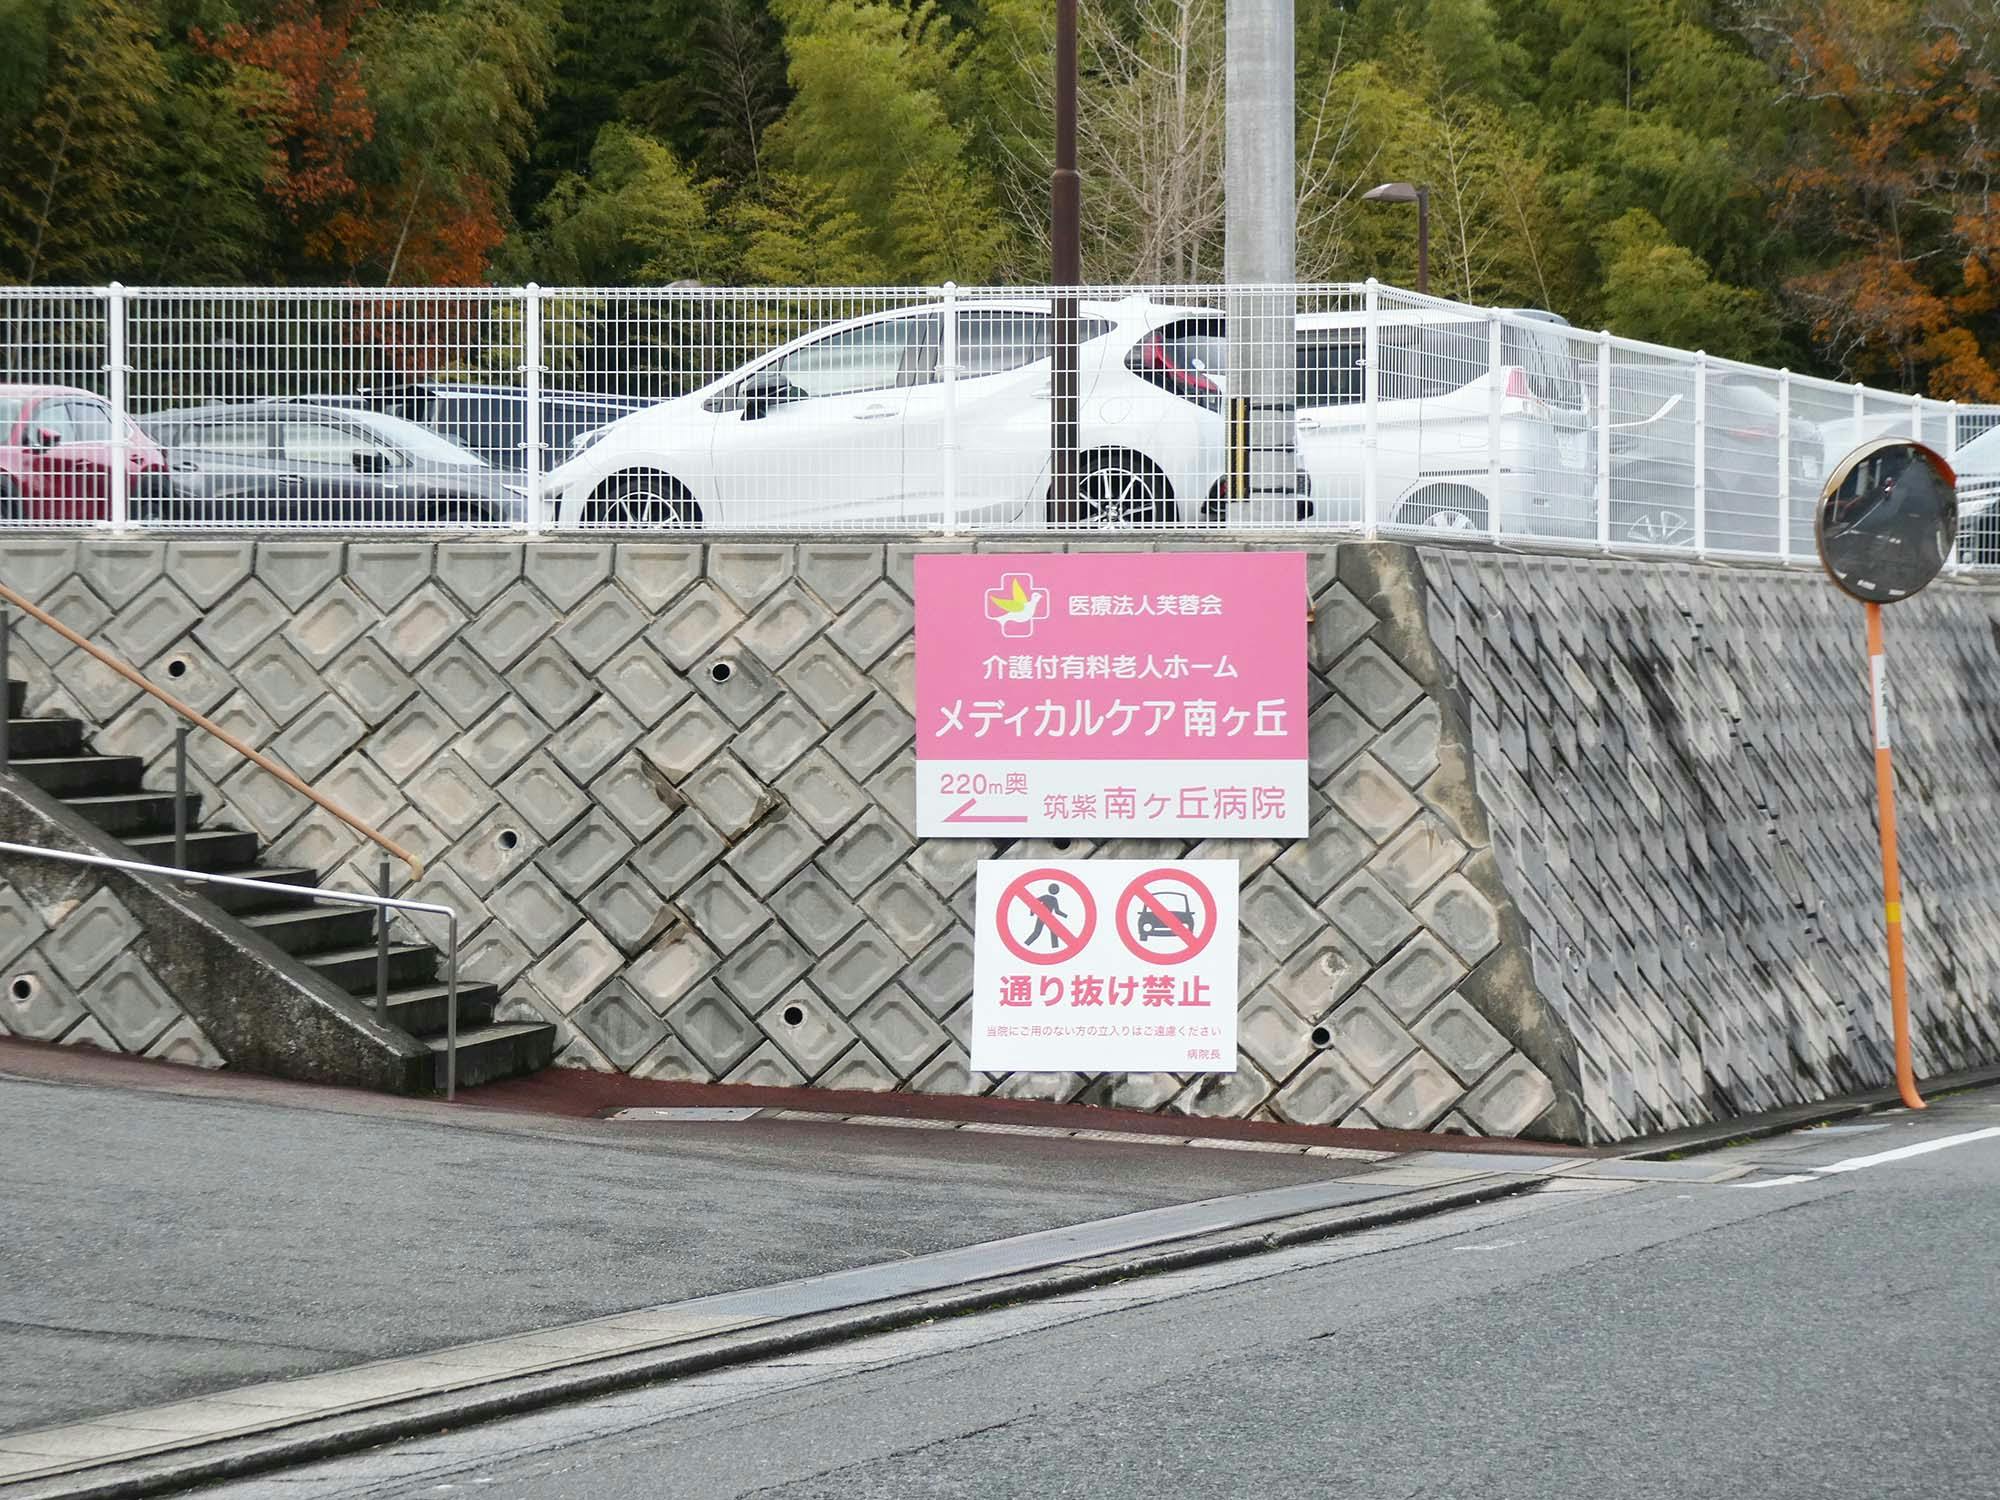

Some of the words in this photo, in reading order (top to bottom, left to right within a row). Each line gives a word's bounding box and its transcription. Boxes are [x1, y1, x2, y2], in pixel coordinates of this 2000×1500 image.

[1068, 594, 1223, 617] 医療法人芙蓉会
[982, 654, 1239, 680] 介護付有料老人ホーム
[935, 698, 1289, 738] メディカルケア南ヶ丘
[939, 772, 1028, 796] 220m奥
[998, 974, 1212, 1008] 通り抜け禁止
[986, 1025, 1222, 1038] 当院にご用のない方の立入りはご遠慮ください
[1186, 1048, 1221, 1060] 病院長
